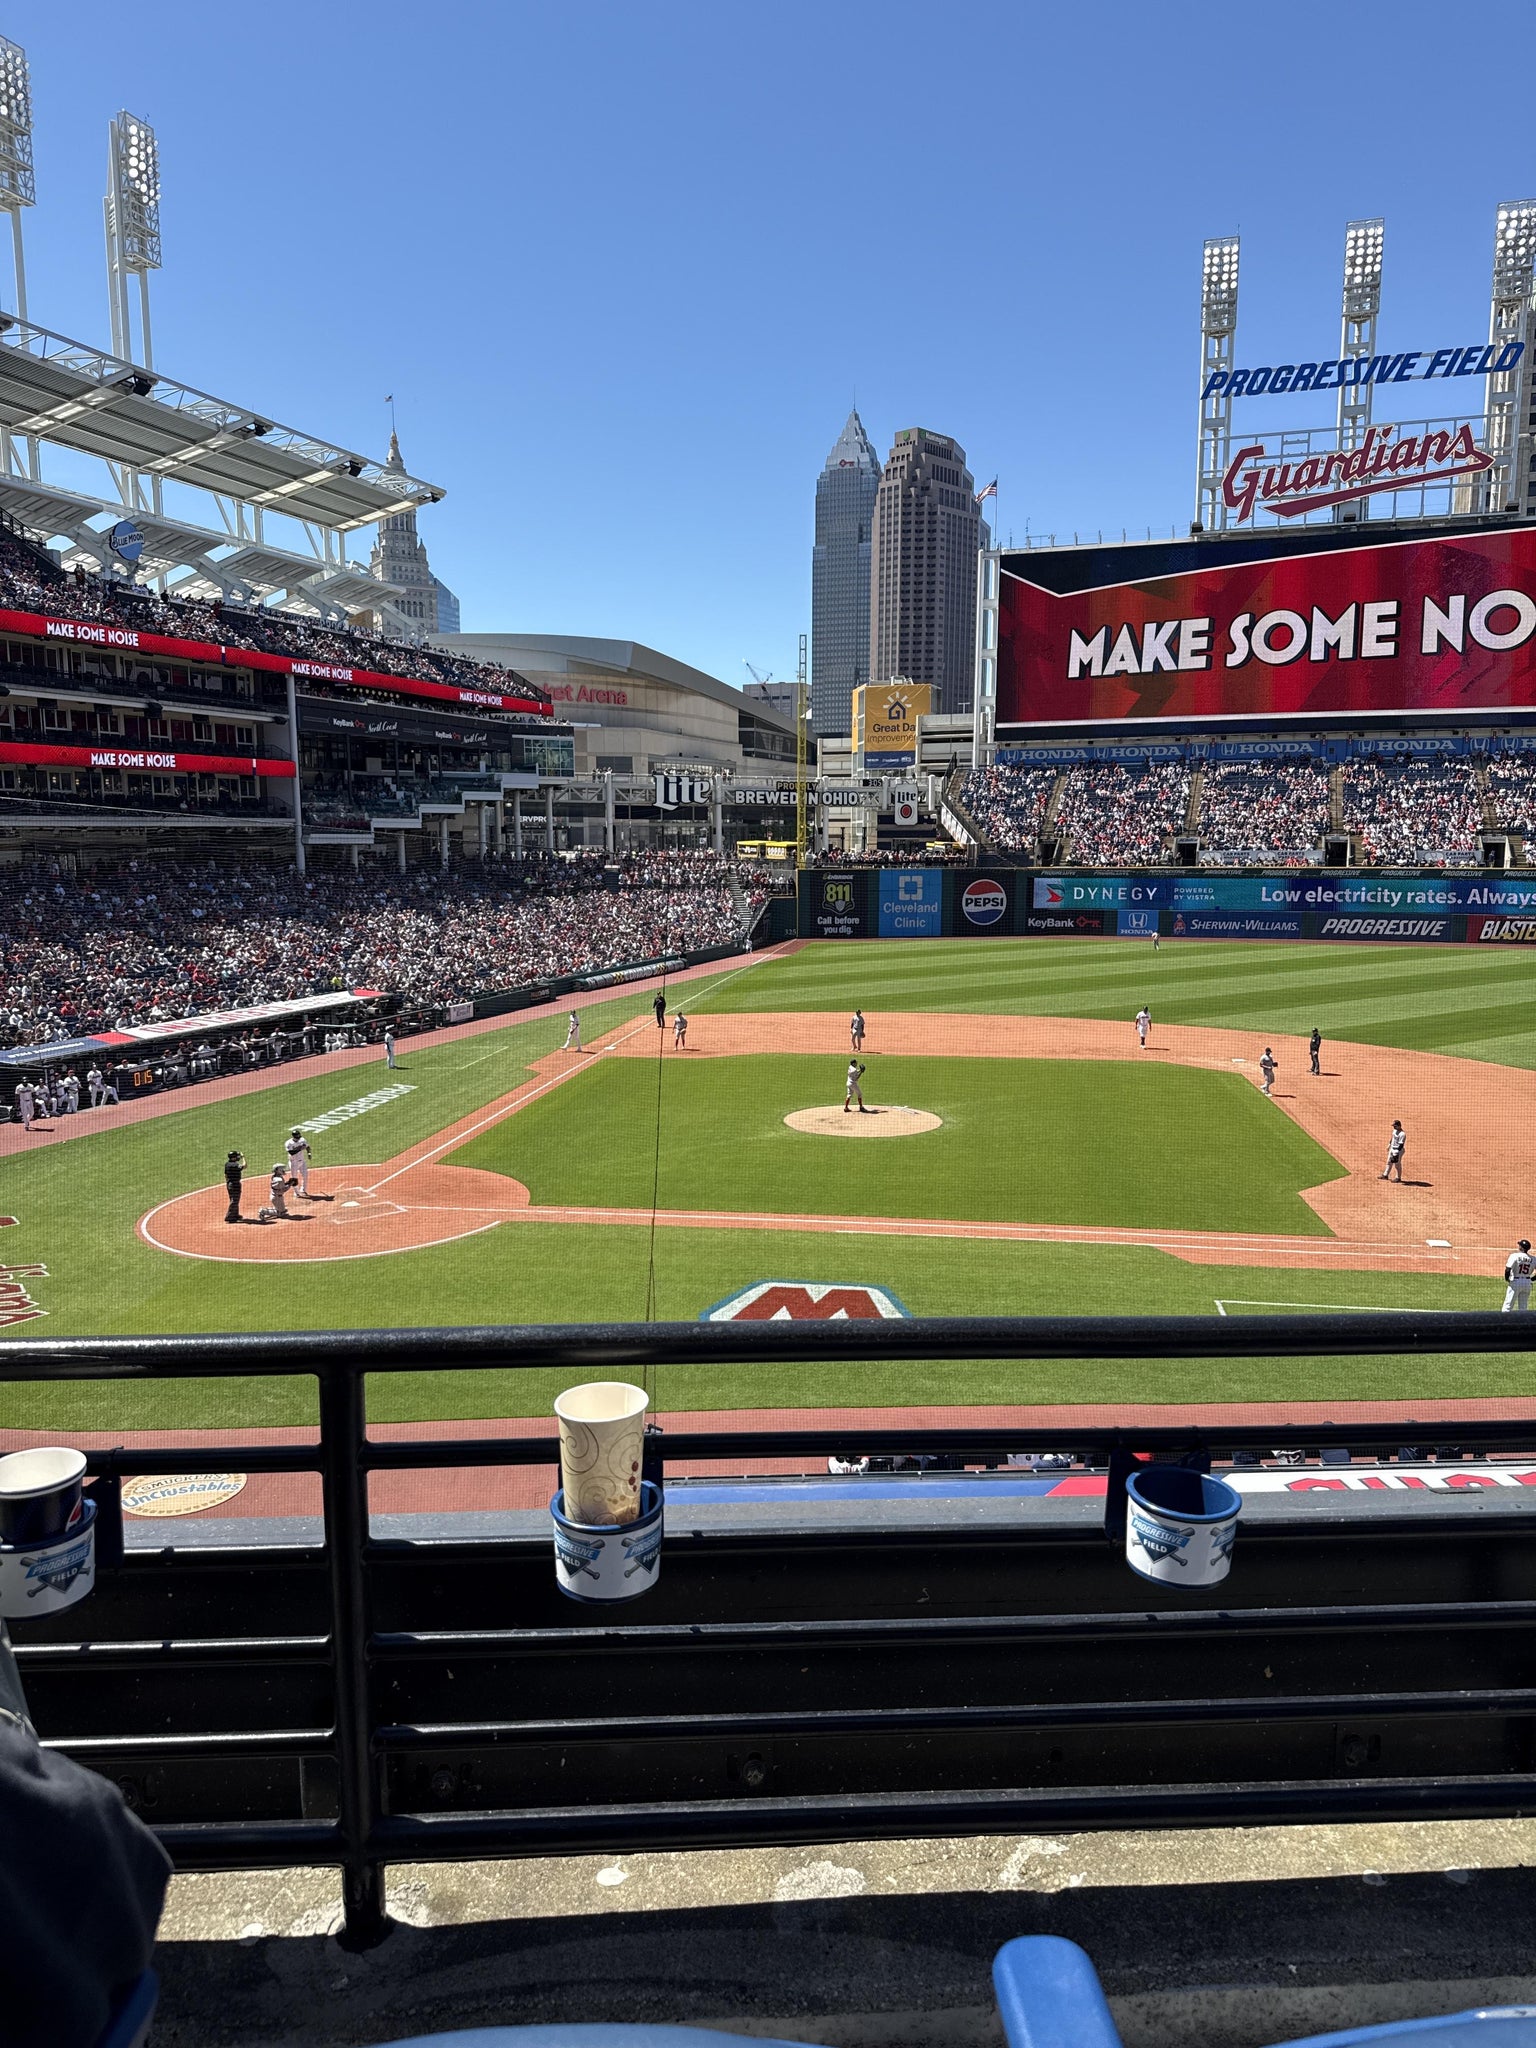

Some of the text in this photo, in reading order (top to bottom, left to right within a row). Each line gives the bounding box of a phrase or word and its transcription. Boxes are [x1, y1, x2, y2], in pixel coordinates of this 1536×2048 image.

[1200, 341, 1525, 400] PROGRESSIVE FIELD
[1221, 421, 1496, 527] Guardians
[112, 532, 144, 548] BLUE MOON
[46, 621, 140, 648] MAKE SOME NOISE
[1067, 588, 1536, 680] MAKE SOME NO
[291, 662, 353, 682] MAKE SOME NOISE
[459, 691, 503, 707] MAKE SOME NOISE
[541, 682, 628, 706] ket Arena
[332, 717, 355, 729] KeyBank
[872, 723, 916, 733] Great Da
[435, 731, 453, 741] KeyBank
[1110, 745, 1182, 758] HONDA
[1239, 743, 1314, 754] HONDA
[1377, 739, 1457, 751] HONDA
[90, 752, 176, 768] MAKE SOME NOISE
[1020, 749, 1089, 761] HONDA
[652, 775, 713, 811] Lite
[777, 782, 818, 790] PROULY
[735, 790, 798, 804] BREWED
[822, 791, 858, 804] OHIO
[897, 791, 916, 804] Lite
[512, 815, 547, 823] ERVPR
[826, 884, 851, 902] 811
[1073, 887, 1158, 900] DYNEGY
[1261, 886, 1536, 909] Low electricity rates. Always
[883, 902, 938, 914] Cleveland
[965, 897, 1003, 907] PEPSI
[817, 916, 860, 924] Call before
[894, 917, 926, 928] Clinic
[1027, 917, 1074, 929] KeyBank
[824, 925, 853, 935] you dig.
[1320, 919, 1446, 936] PROGRESSIVE
[288, 1083, 419, 1133] PROGRESSIVE
[1519, 1264, 1530, 1274] 15
[122, 1482, 241, 1508] Uncrustables
[1133, 1519, 1183, 1545] PROGRESSIVE
[556, 1536, 594, 1558] OGRESSIVE
[1143, 1538, 1167, 1553] FIELD
[32, 1549, 89, 1576] PROGRESSIVE
[561, 1552, 580, 1566] FIELD
[51, 1567, 78, 1582] FIELD
